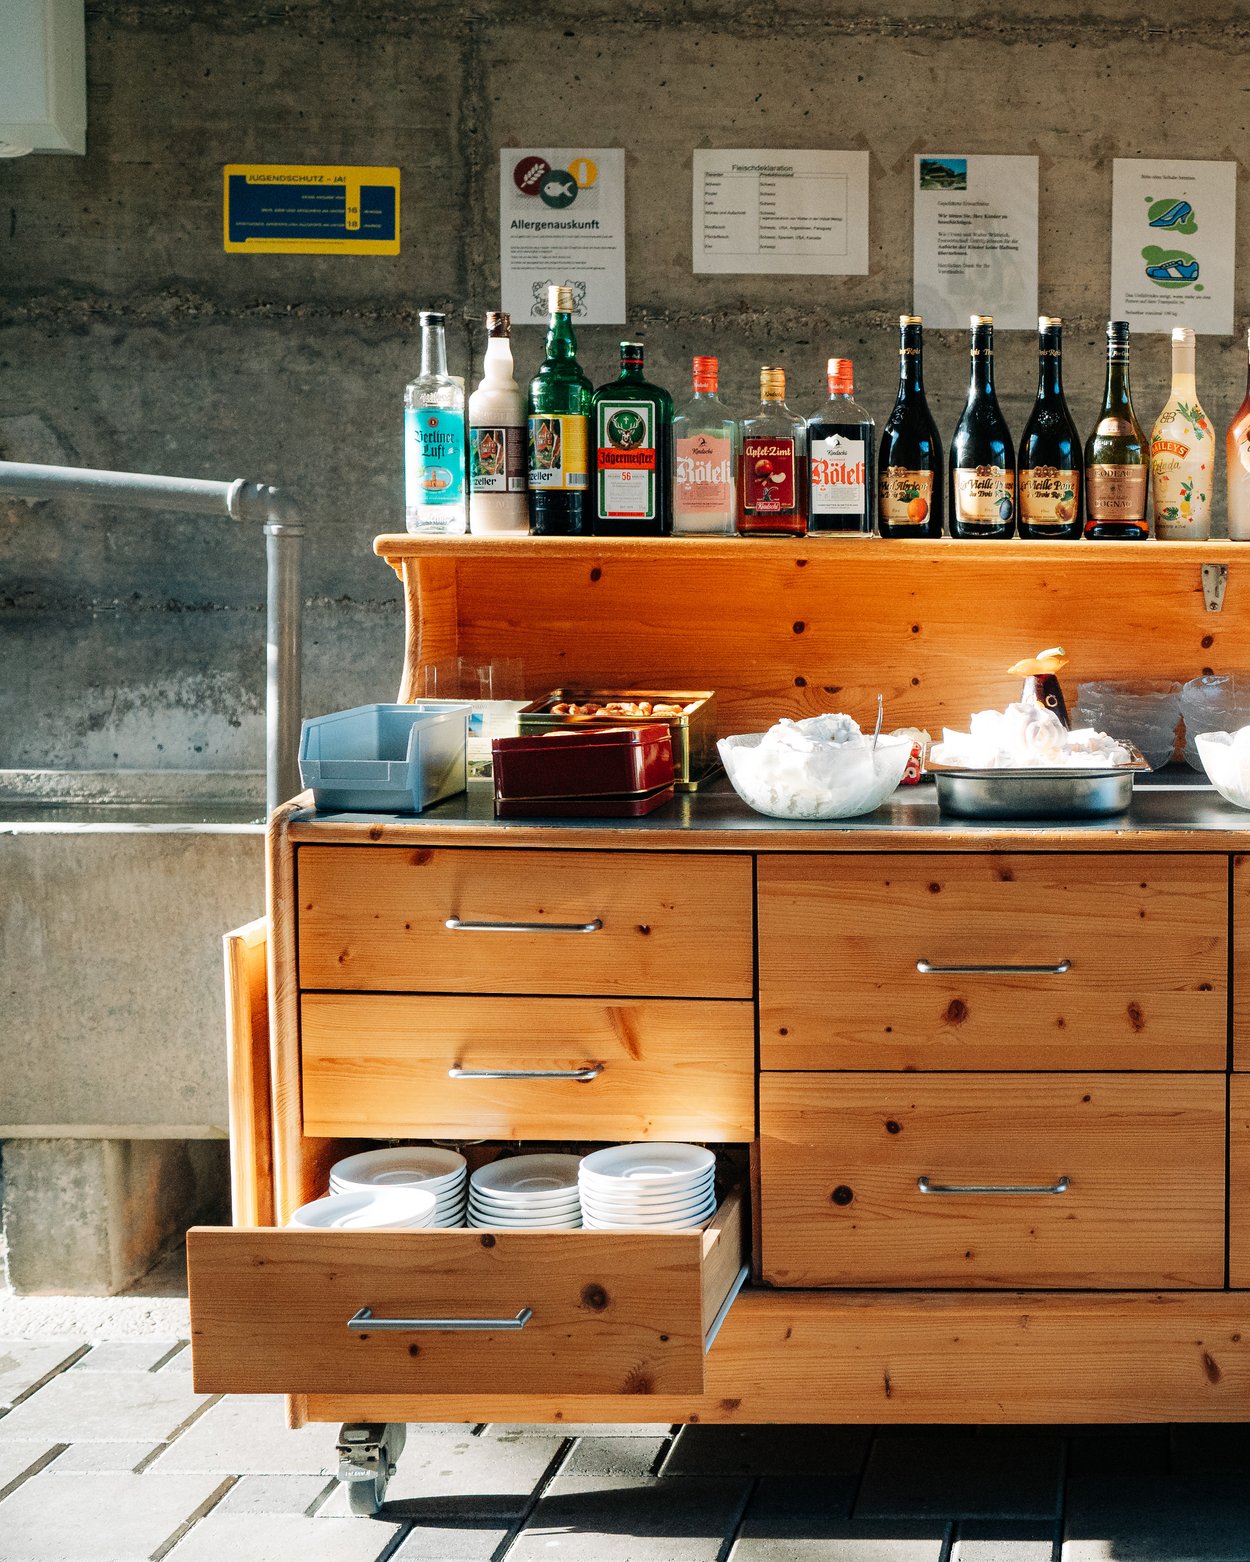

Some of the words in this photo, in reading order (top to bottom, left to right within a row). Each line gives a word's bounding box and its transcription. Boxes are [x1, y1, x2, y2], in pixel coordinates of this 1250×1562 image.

[731, 164, 794, 172] Fleischdeklaration
[248, 174, 324, 183] JUGENDSCHUTZ
[347, 206, 358, 214] 16
[510, 219, 600, 231] Allergenauskunft
[414, 430, 455, 444] Berliner
[421, 444, 446, 460] Luft
[600, 451, 654, 465] Jägermeister
[745, 445, 792, 458] Apfel-Zimt
[621, 471, 632, 481] 56
[676, 455, 731, 486] Röteli
[810, 457, 866, 486] Röteli
[968, 478, 994, 490] Vieille
[1029, 477, 1053, 490] Vieille
